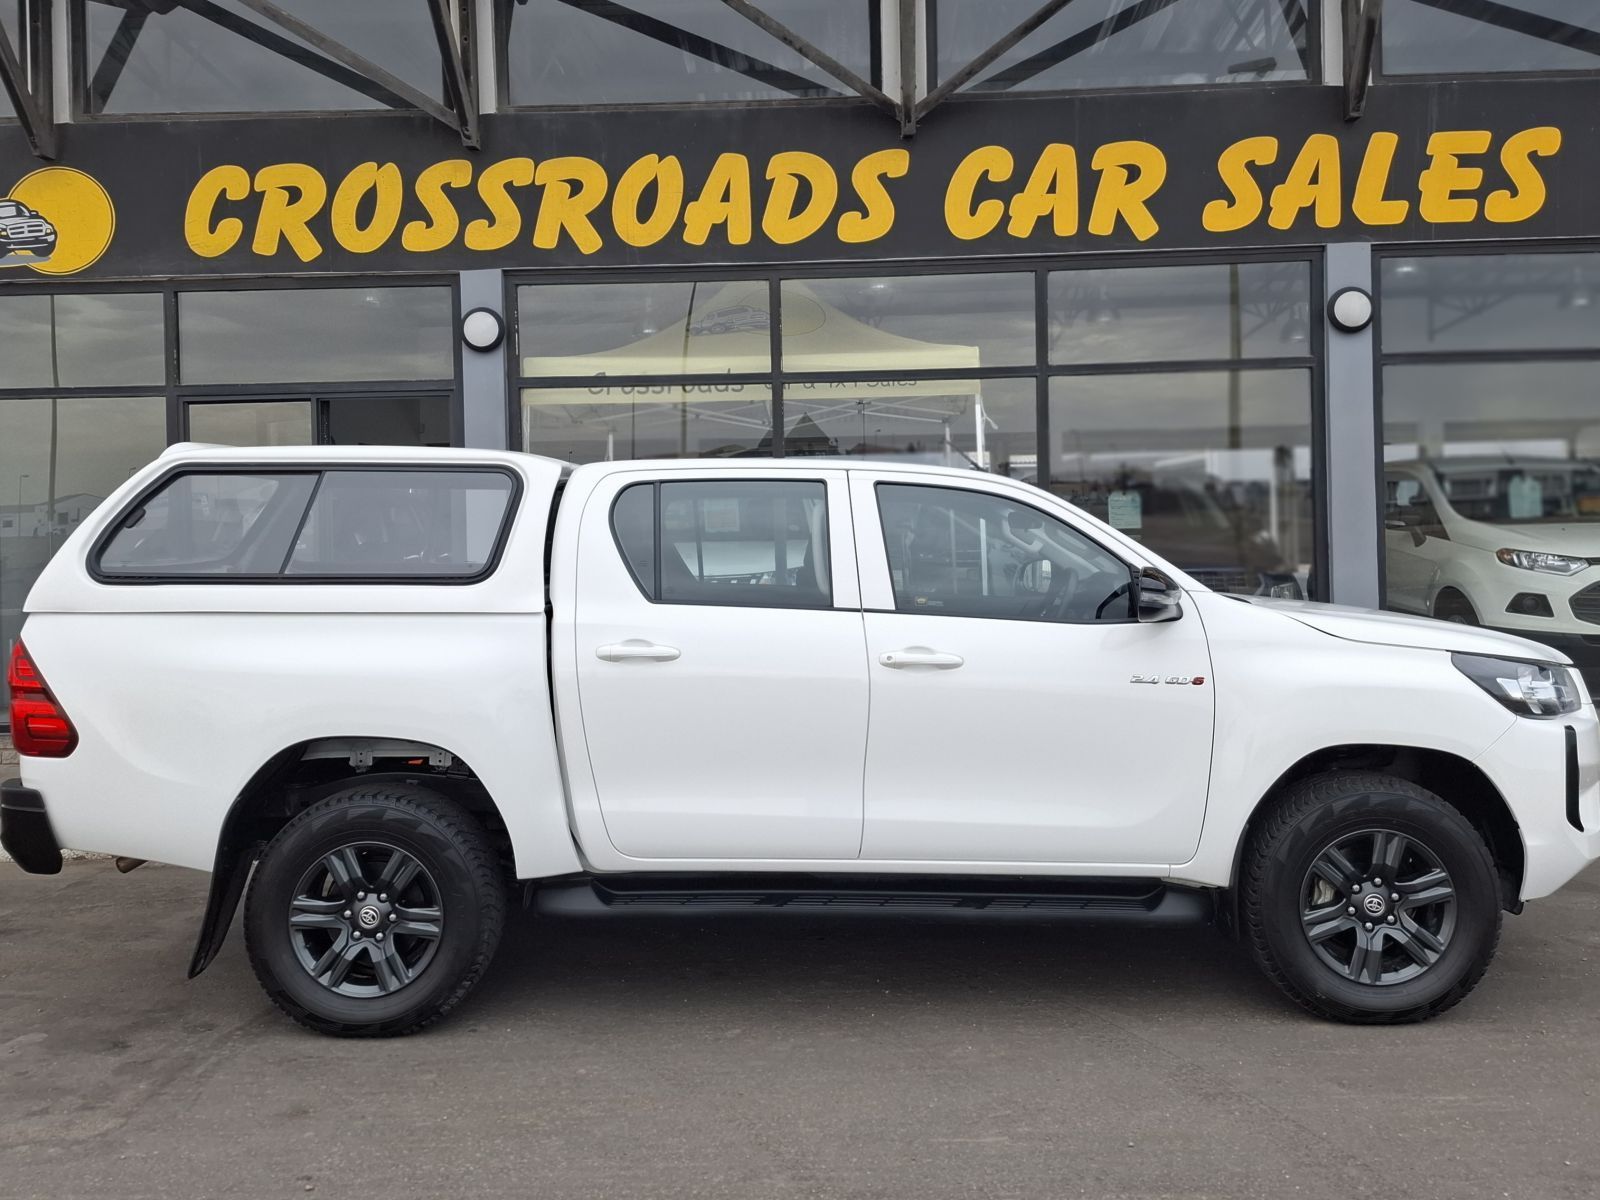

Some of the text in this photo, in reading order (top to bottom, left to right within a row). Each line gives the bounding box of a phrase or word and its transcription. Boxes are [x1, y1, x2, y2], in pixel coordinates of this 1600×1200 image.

[185, 127, 1561, 262] CROSSROADS CAR SALES
